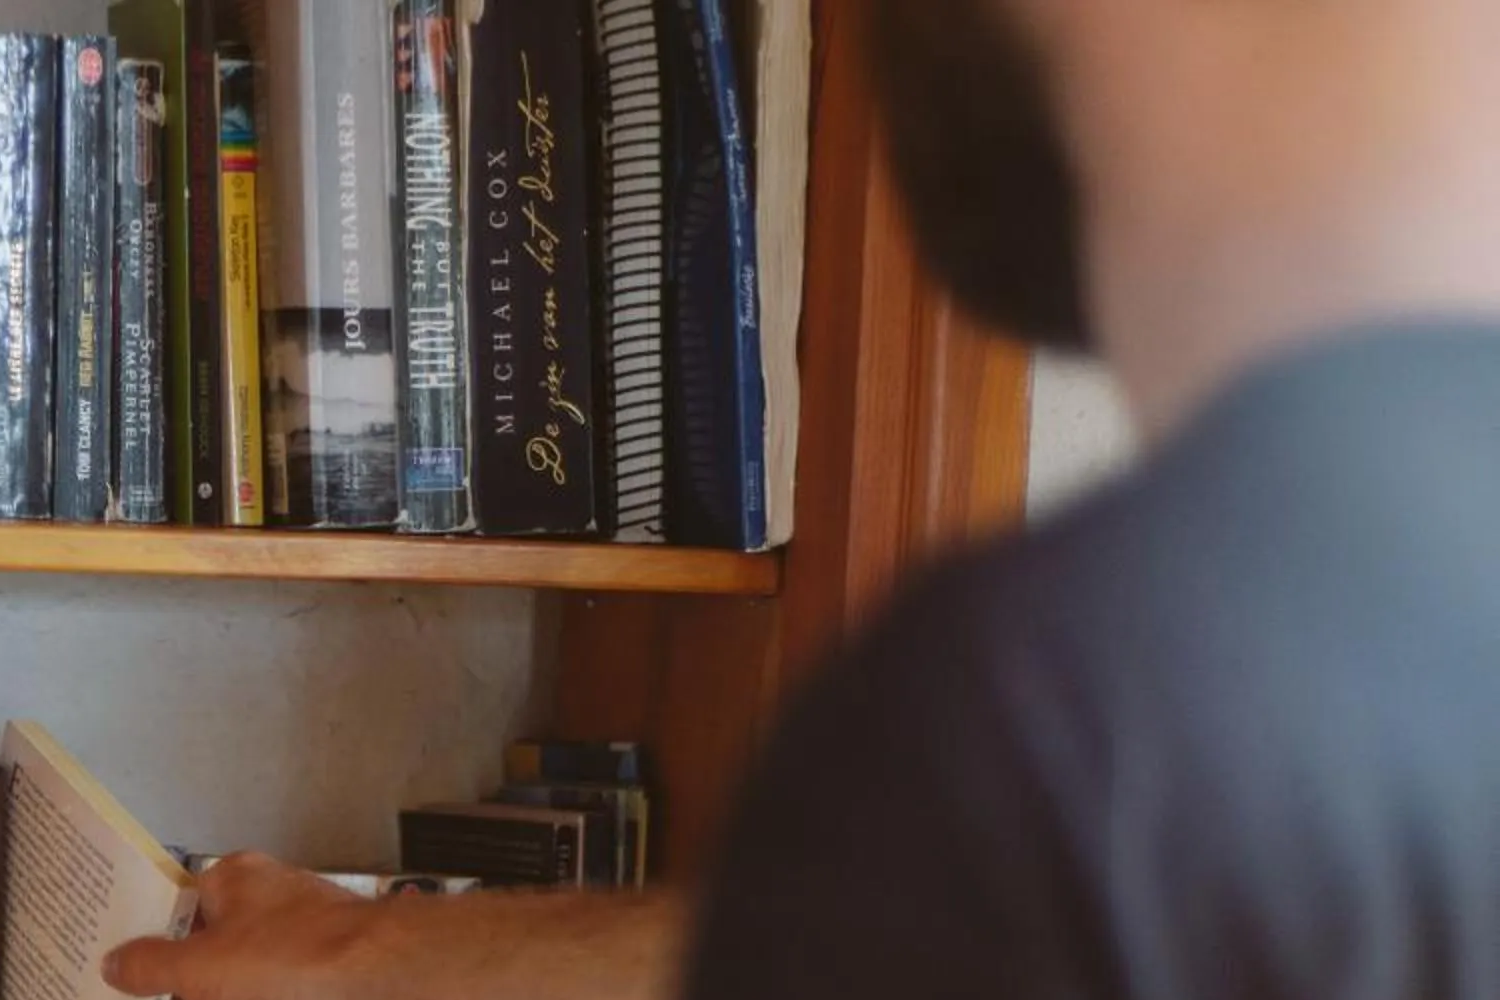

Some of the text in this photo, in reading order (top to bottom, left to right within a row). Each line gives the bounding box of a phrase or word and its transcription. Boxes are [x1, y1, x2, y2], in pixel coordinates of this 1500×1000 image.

[336, 91, 366, 350] JOURS BARBARES
[405, 113, 452, 229] NOTHING
[411, 241, 424, 292] THE
[436, 241, 450, 292] BUT
[487, 147, 514, 434] MICHAEL COX
[517, 49, 585, 485] De zin van het duister
[125, 323, 140, 451] PIMPERNEL
[139, 339, 155, 436] SCARLET
[410, 302, 454, 389] TRUTH
[76, 399, 92, 481] TOM CLANCY
